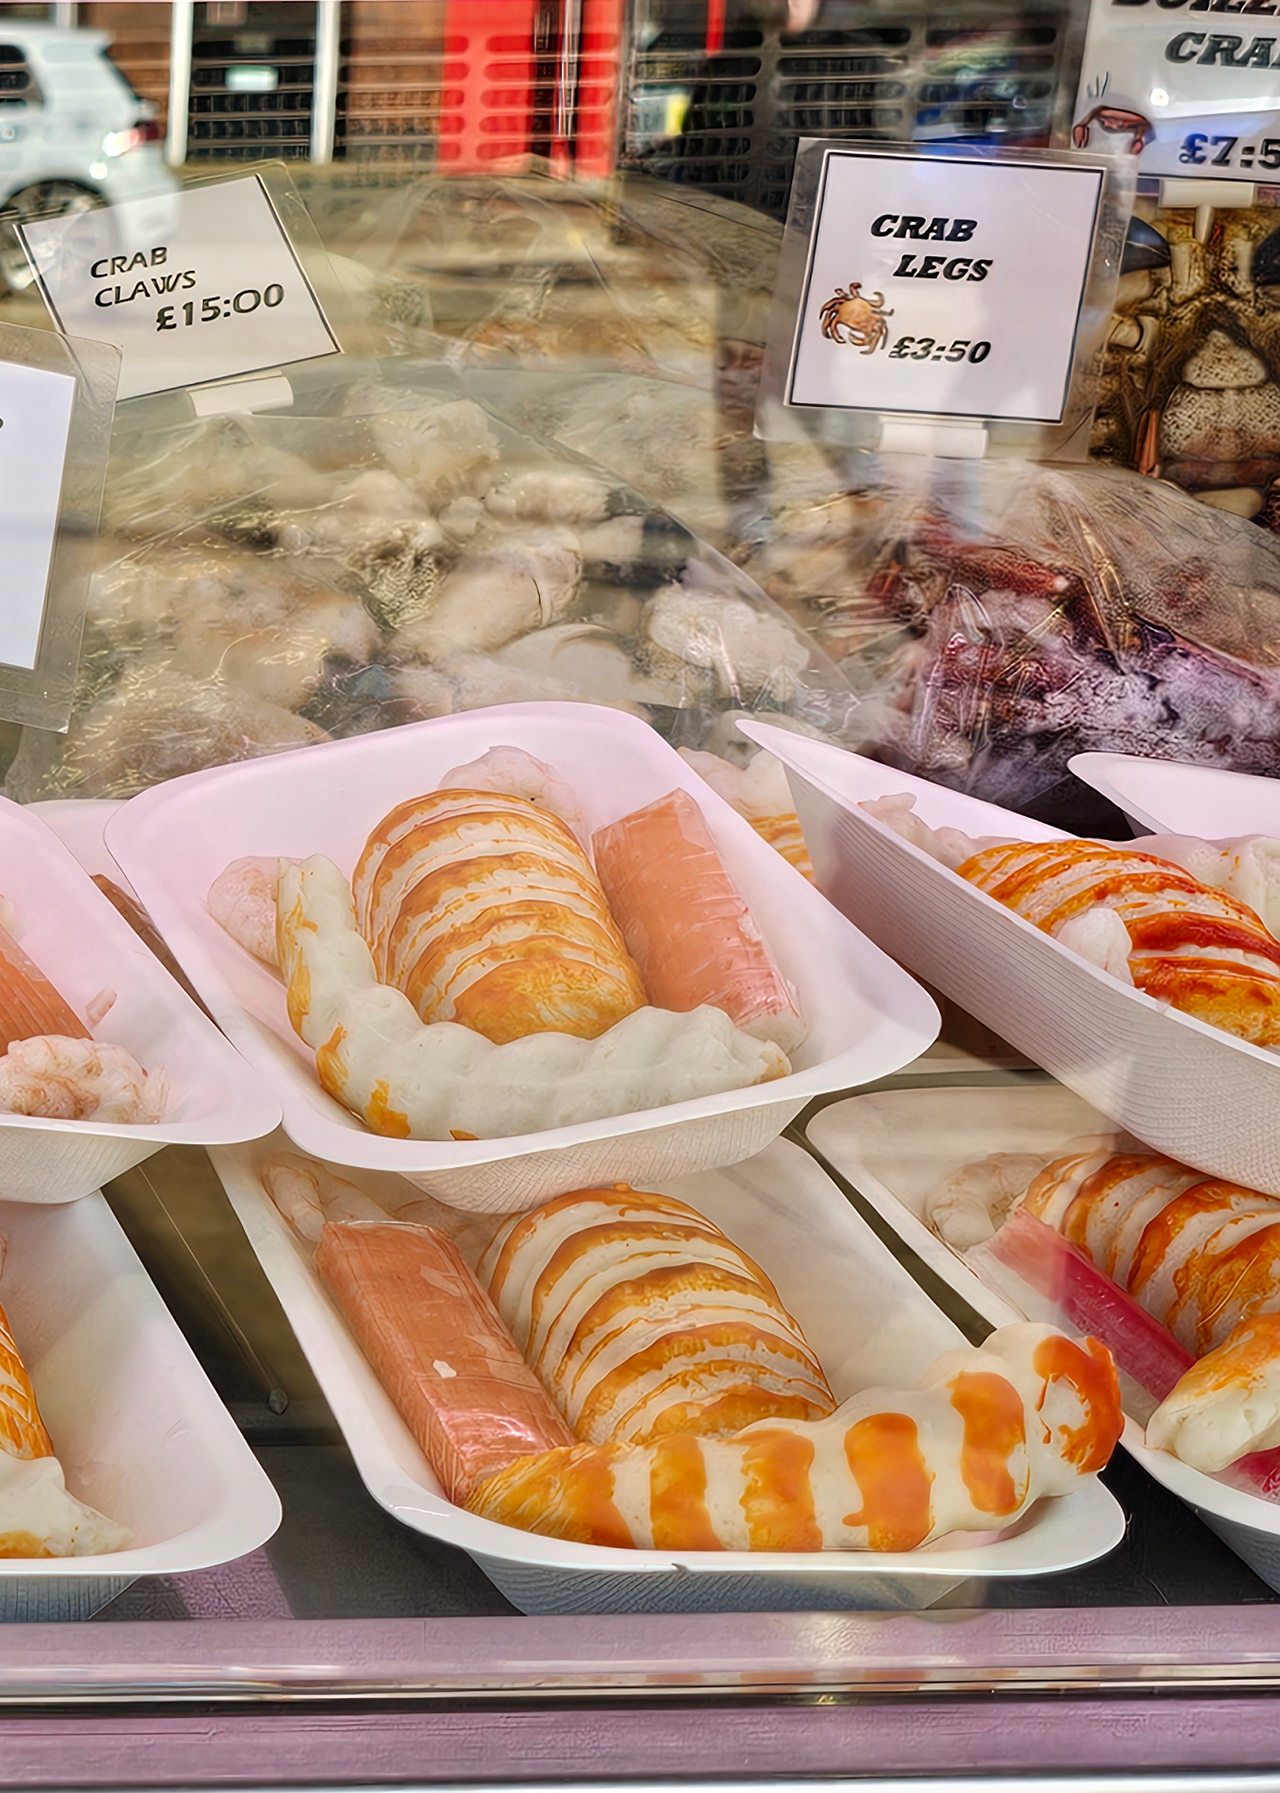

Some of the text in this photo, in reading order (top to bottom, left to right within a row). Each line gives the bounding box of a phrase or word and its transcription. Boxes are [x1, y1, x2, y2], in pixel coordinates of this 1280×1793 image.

[1164, 32, 1280, 70] CRA
[870, 214, 978, 242] CRAB
[90, 246, 168, 278] CRAB
[893, 254, 994, 282] LEGS
[94, 270, 197, 307] CLAWS
[155, 283, 285, 332] £15:00
[888, 336, 991, 364] £3:50
